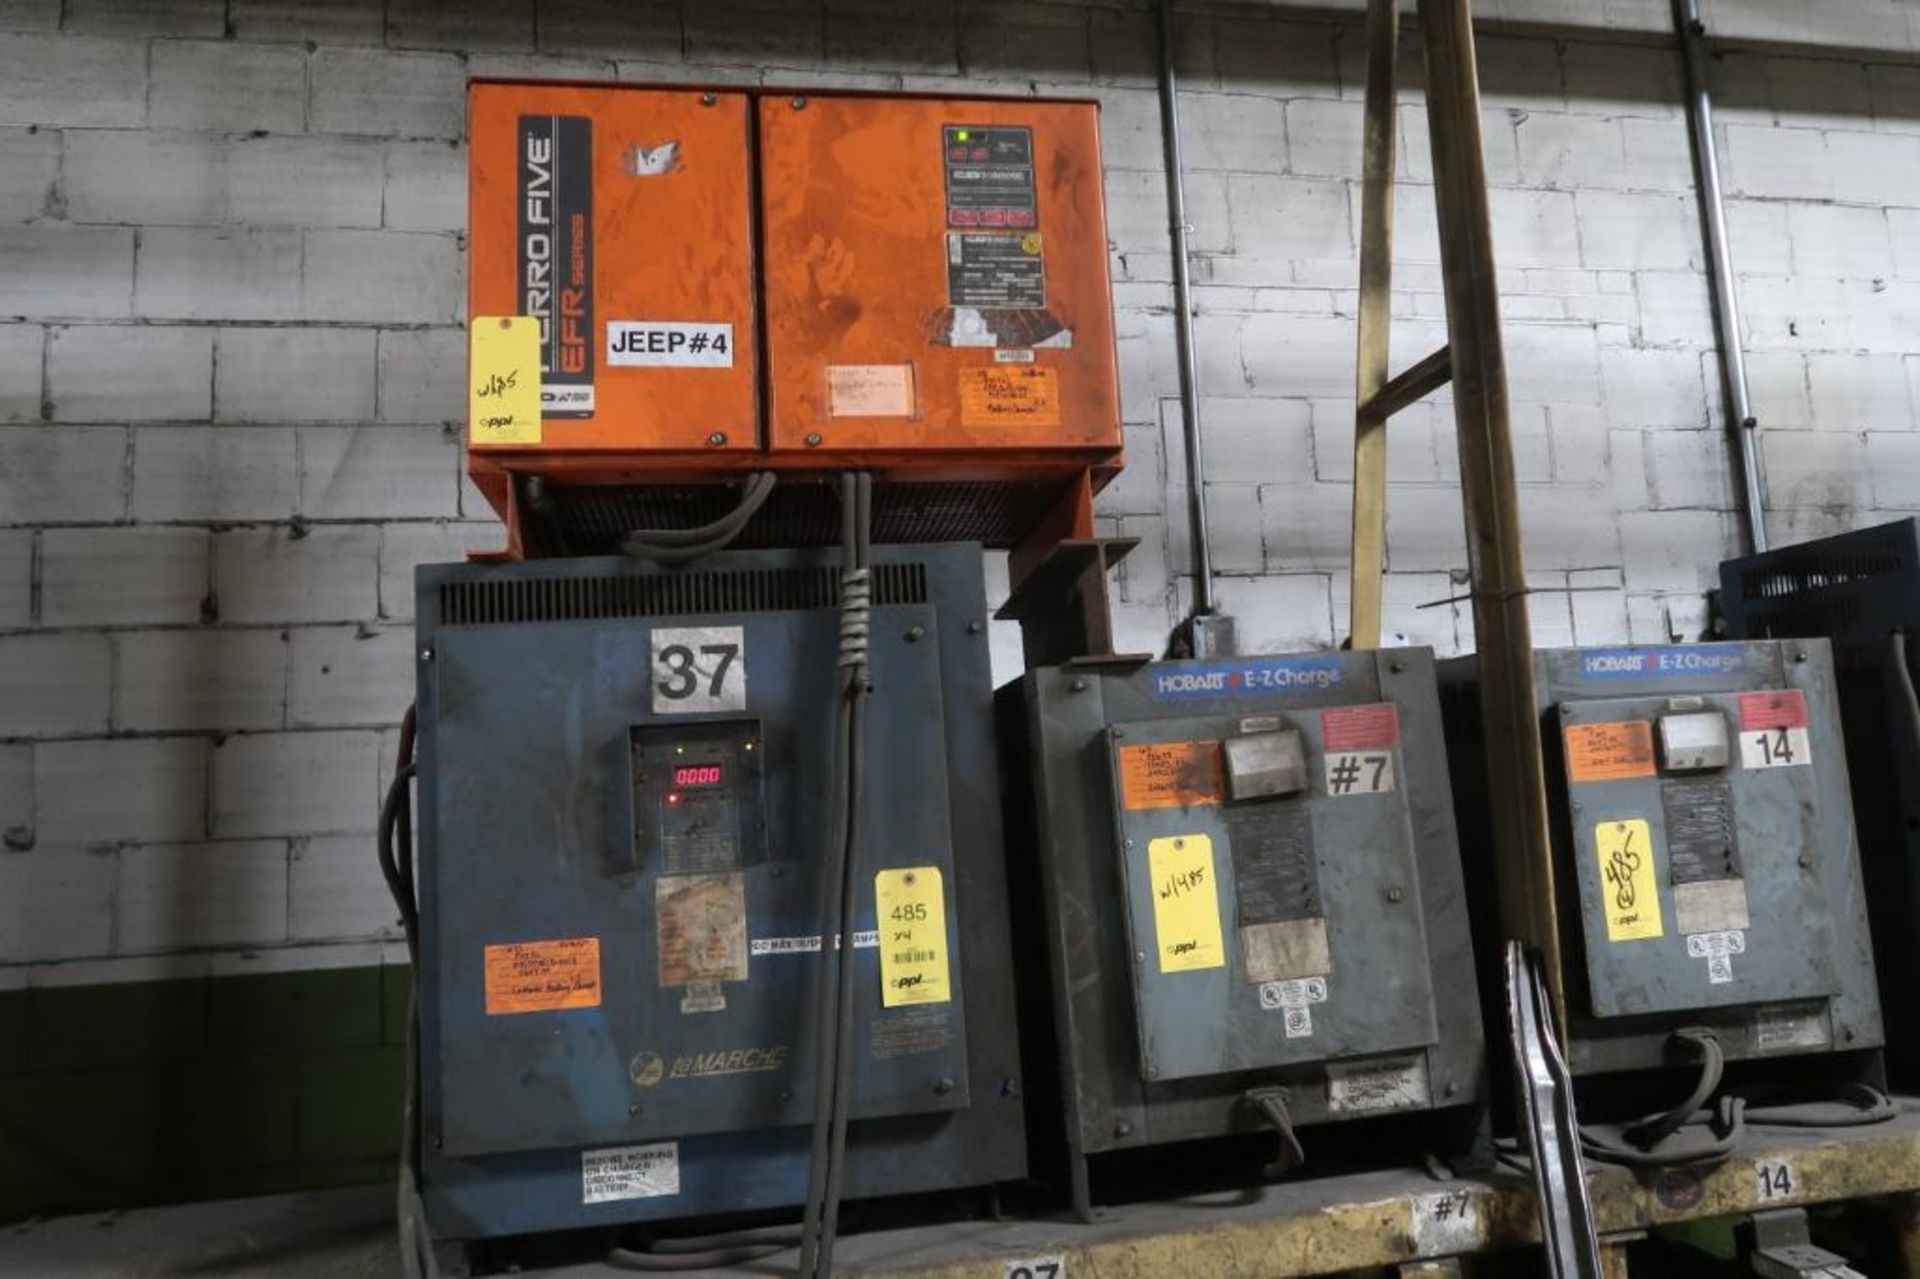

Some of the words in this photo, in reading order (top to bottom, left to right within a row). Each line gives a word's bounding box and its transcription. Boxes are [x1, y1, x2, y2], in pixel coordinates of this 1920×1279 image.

[527, 137, 550, 225] FIVE
[571, 213, 585, 285] SERIES
[561, 287, 585, 373] EFR
[658, 644, 739, 699] 37
[1585, 654, 1645, 673] HOBART
[1158, 673, 1226, 693] HOBART
[1756, 731, 1794, 765] 14
[676, 767, 721, 785] 0000
[1330, 756, 1387, 794] #7
[891, 904, 927, 922] 485
[1758, 1165, 1792, 1197] 14
[1435, 1191, 1471, 1222] #7
